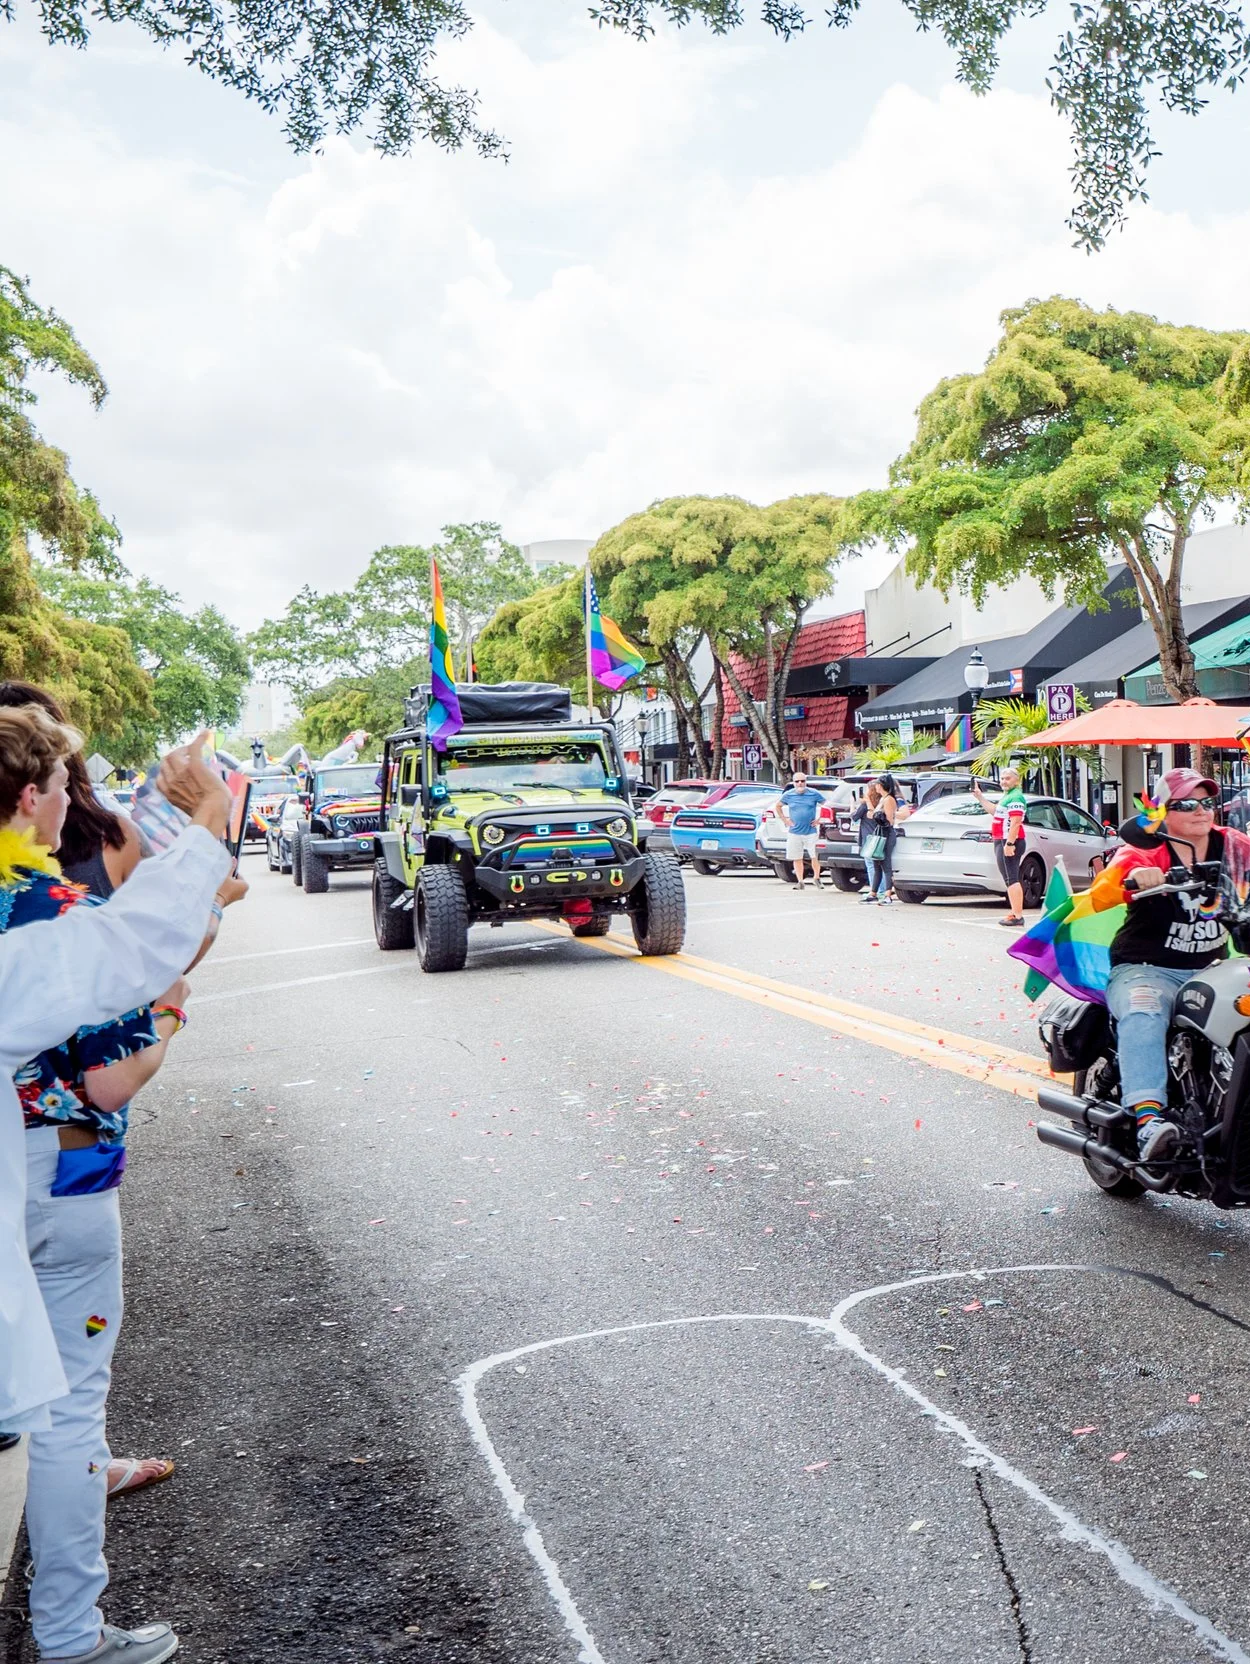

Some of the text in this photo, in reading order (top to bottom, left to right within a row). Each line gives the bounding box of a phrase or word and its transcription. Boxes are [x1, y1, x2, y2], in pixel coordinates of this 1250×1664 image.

[1051, 686, 1069, 694] PAY
[1050, 712, 1074, 721] HERE
[1169, 921, 1195, 942] I'M
[1194, 920, 1218, 940] SO
